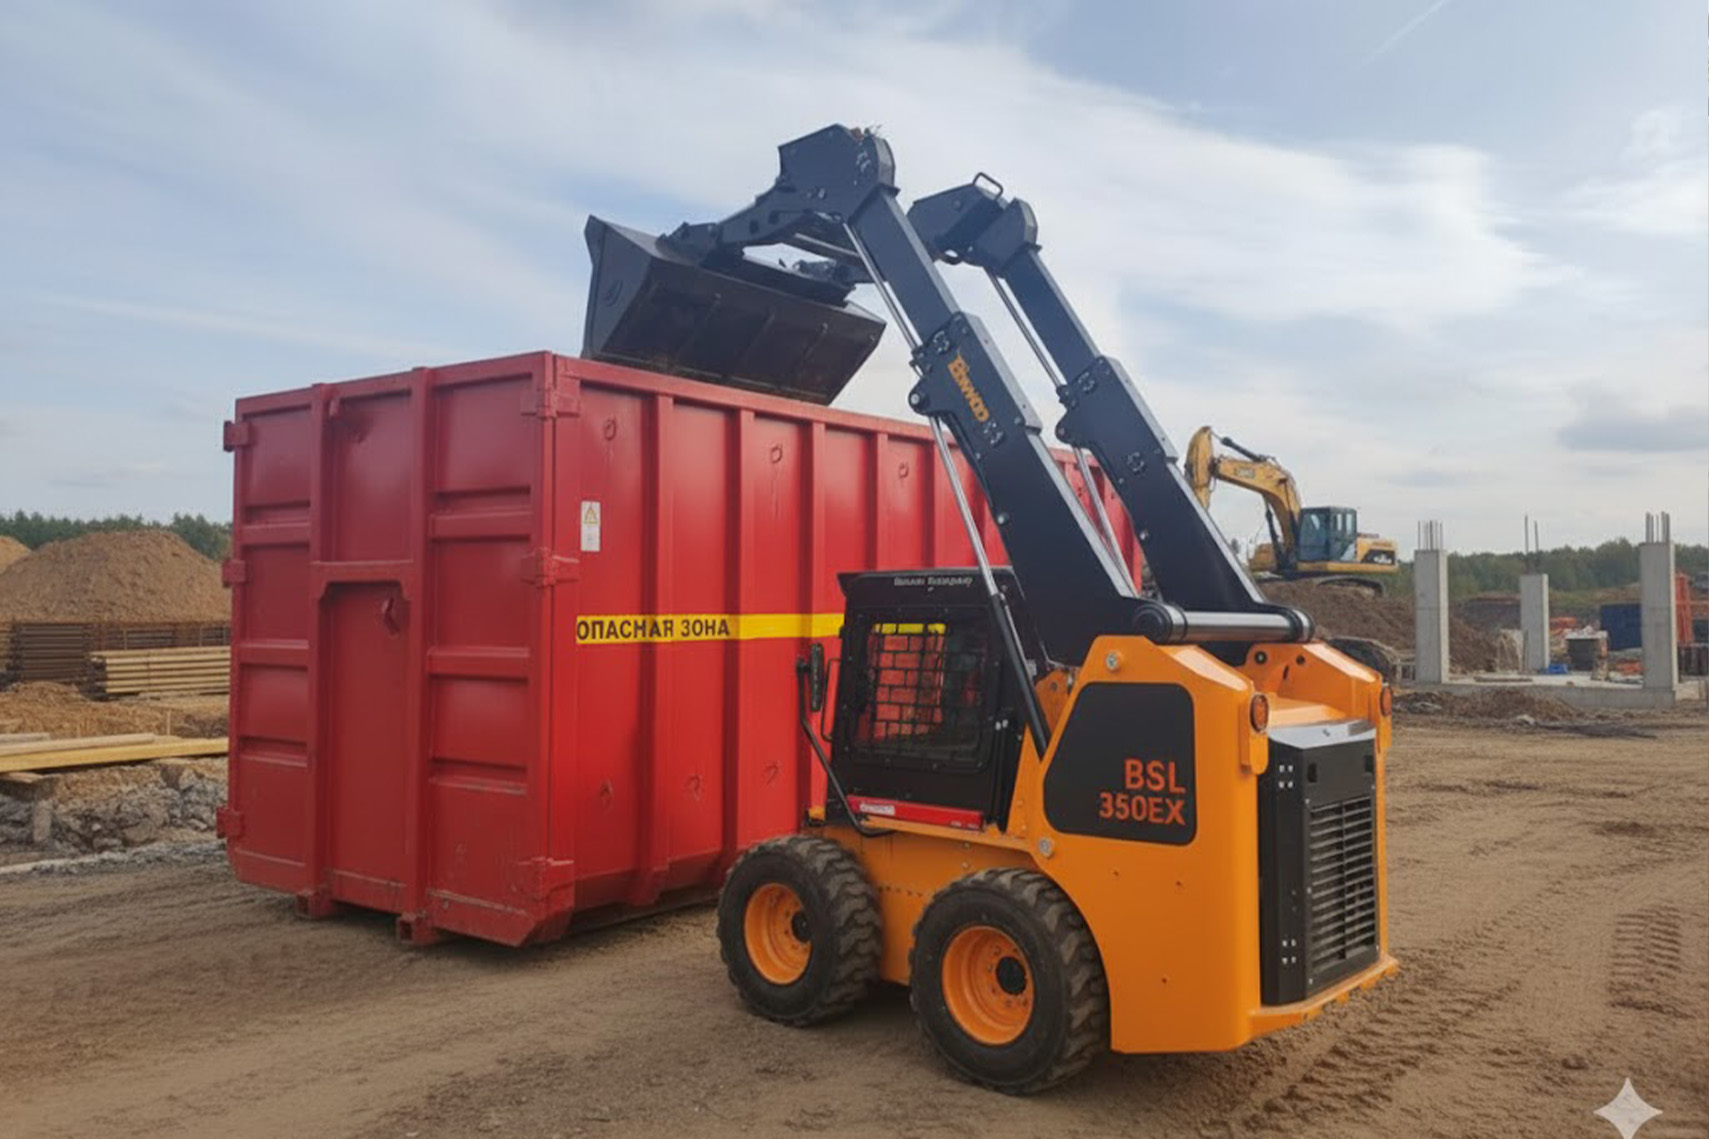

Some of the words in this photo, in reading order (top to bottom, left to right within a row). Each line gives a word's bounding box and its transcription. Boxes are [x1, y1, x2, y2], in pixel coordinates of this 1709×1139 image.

[576, 620, 674, 640] ОПАСНАЯ
[681, 619, 730, 637] ЗОНА
[1124, 758, 1186, 793] BSL
[1099, 792, 1186, 826] 350EX
